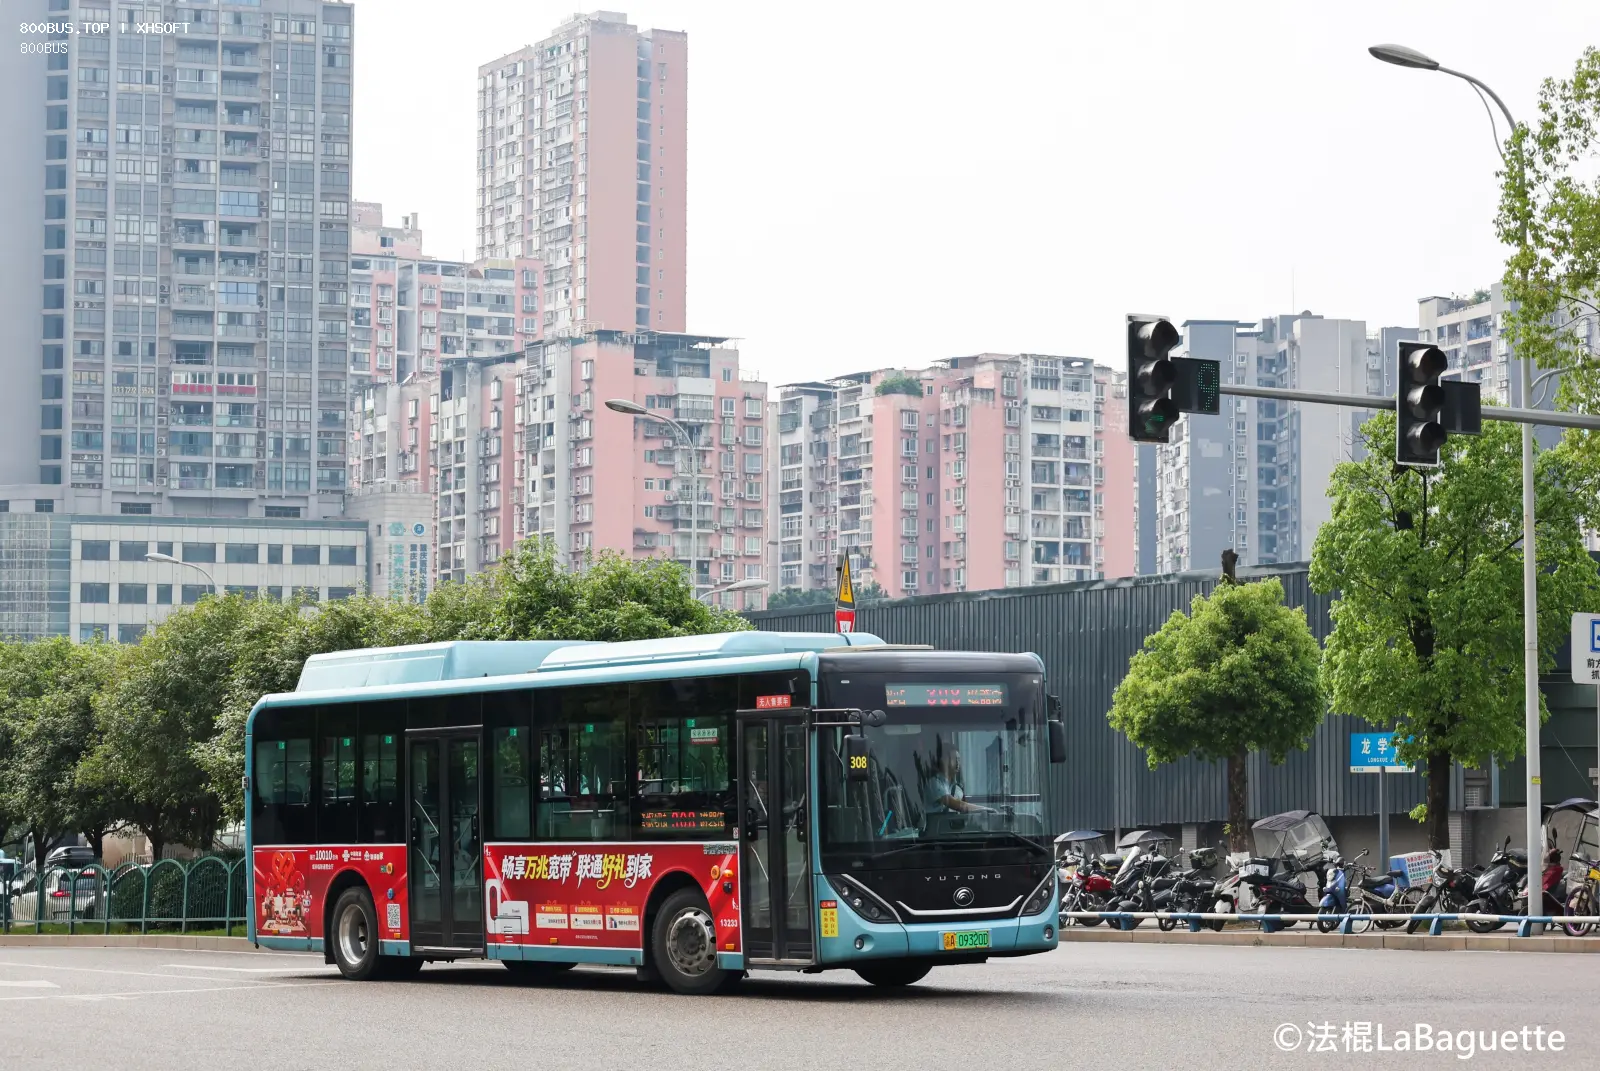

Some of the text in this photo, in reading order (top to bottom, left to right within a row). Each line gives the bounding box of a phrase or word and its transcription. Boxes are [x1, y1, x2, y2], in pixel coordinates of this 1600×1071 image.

[1197, 363, 1218, 411] 9
[759, 696, 789, 707] 无人售票车
[850, 755, 867, 769] 308
[501, 852, 653, 890] 畅享万兆宽带 联通好礼到家
[924, 873, 1001, 882] YUTONG
[720, 918, 738, 928] 13233
